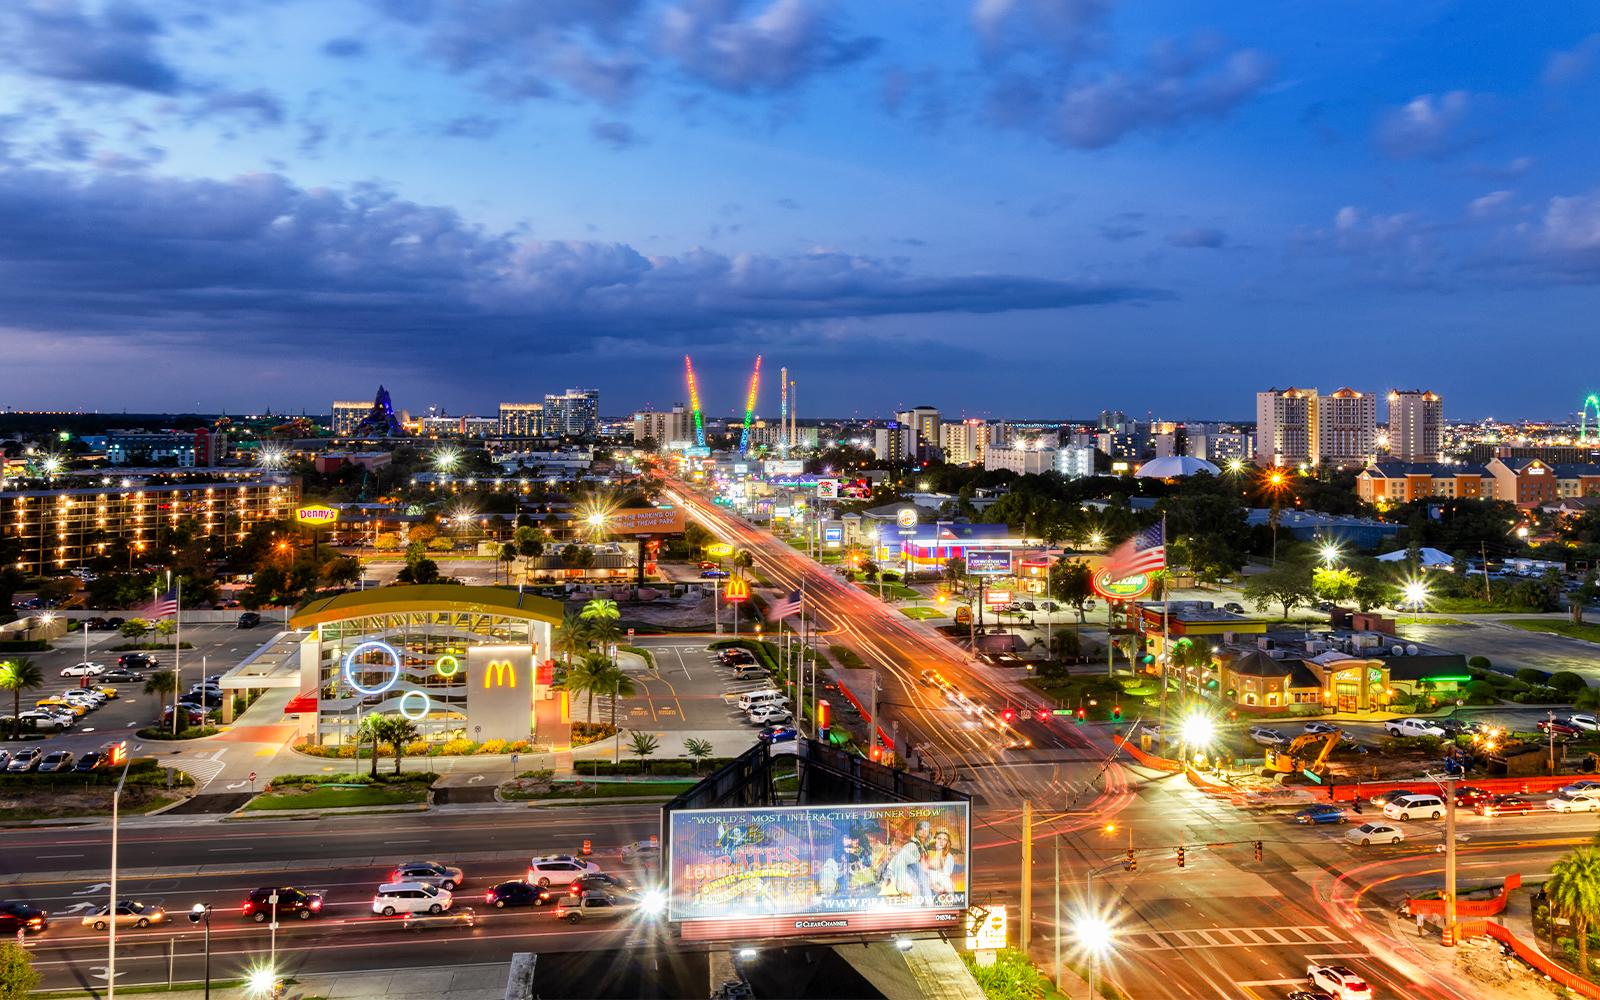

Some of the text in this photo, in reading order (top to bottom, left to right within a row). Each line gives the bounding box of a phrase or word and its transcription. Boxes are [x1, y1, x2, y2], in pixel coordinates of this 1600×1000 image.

[300, 509, 335, 520] Denny's
[751, 814, 782, 822] MOST
[787, 811, 858, 823] INTERACTIVE
[863, 810, 904, 820] DINNER
[702, 875, 736, 894] DINNER
[824, 894, 965, 908] WWW.PIRATESHOW.COM
